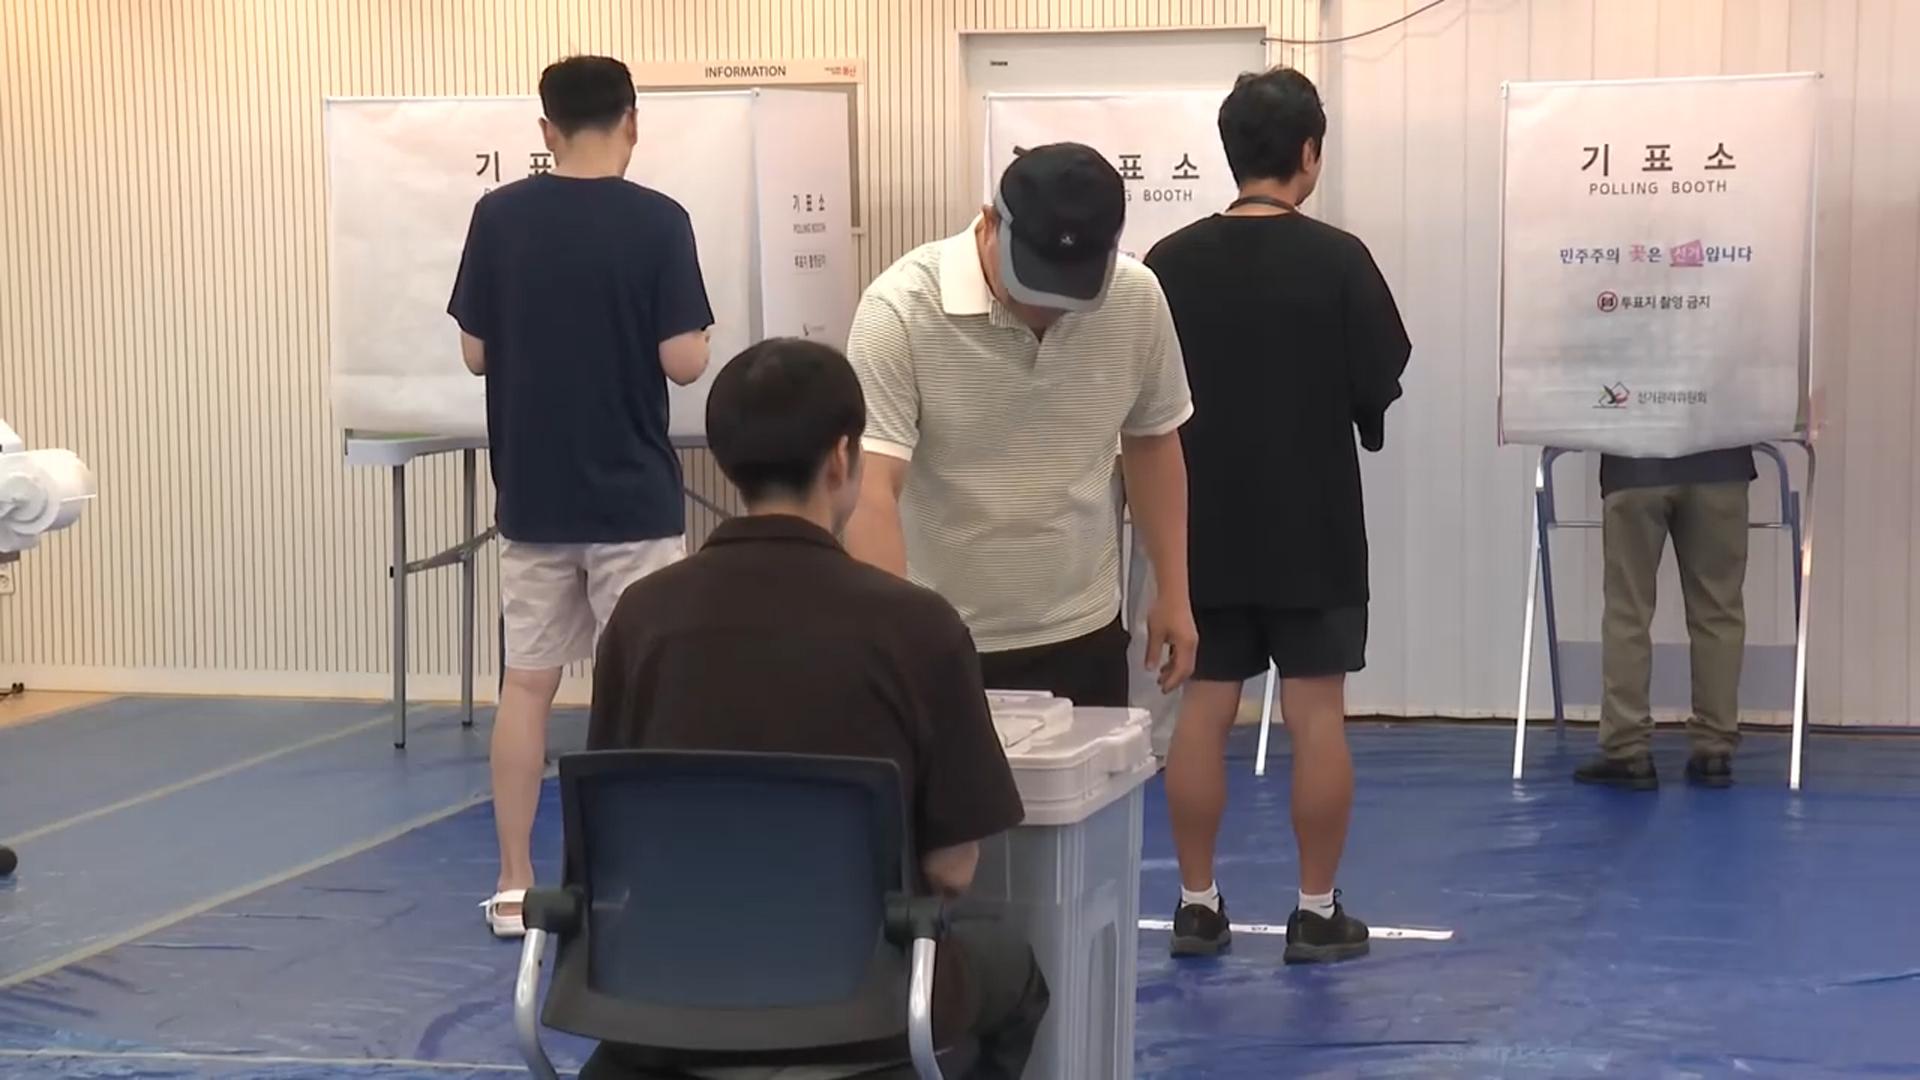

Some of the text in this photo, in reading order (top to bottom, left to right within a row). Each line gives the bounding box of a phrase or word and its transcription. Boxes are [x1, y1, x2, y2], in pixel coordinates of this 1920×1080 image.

[705, 66, 787, 78] INFORMATION
[476, 150, 552, 182] 기표
[1118, 153, 1200, 180] 표소
[1589, 180, 1727, 195] POLLING BOOTH
[1143, 189, 1193, 202] BOOTH
[1560, 247, 1620, 264] 민주주의
[1630, 244, 1663, 263] 꽃은
[1621, 295, 1710, 309] 투표지 촬영 금지
